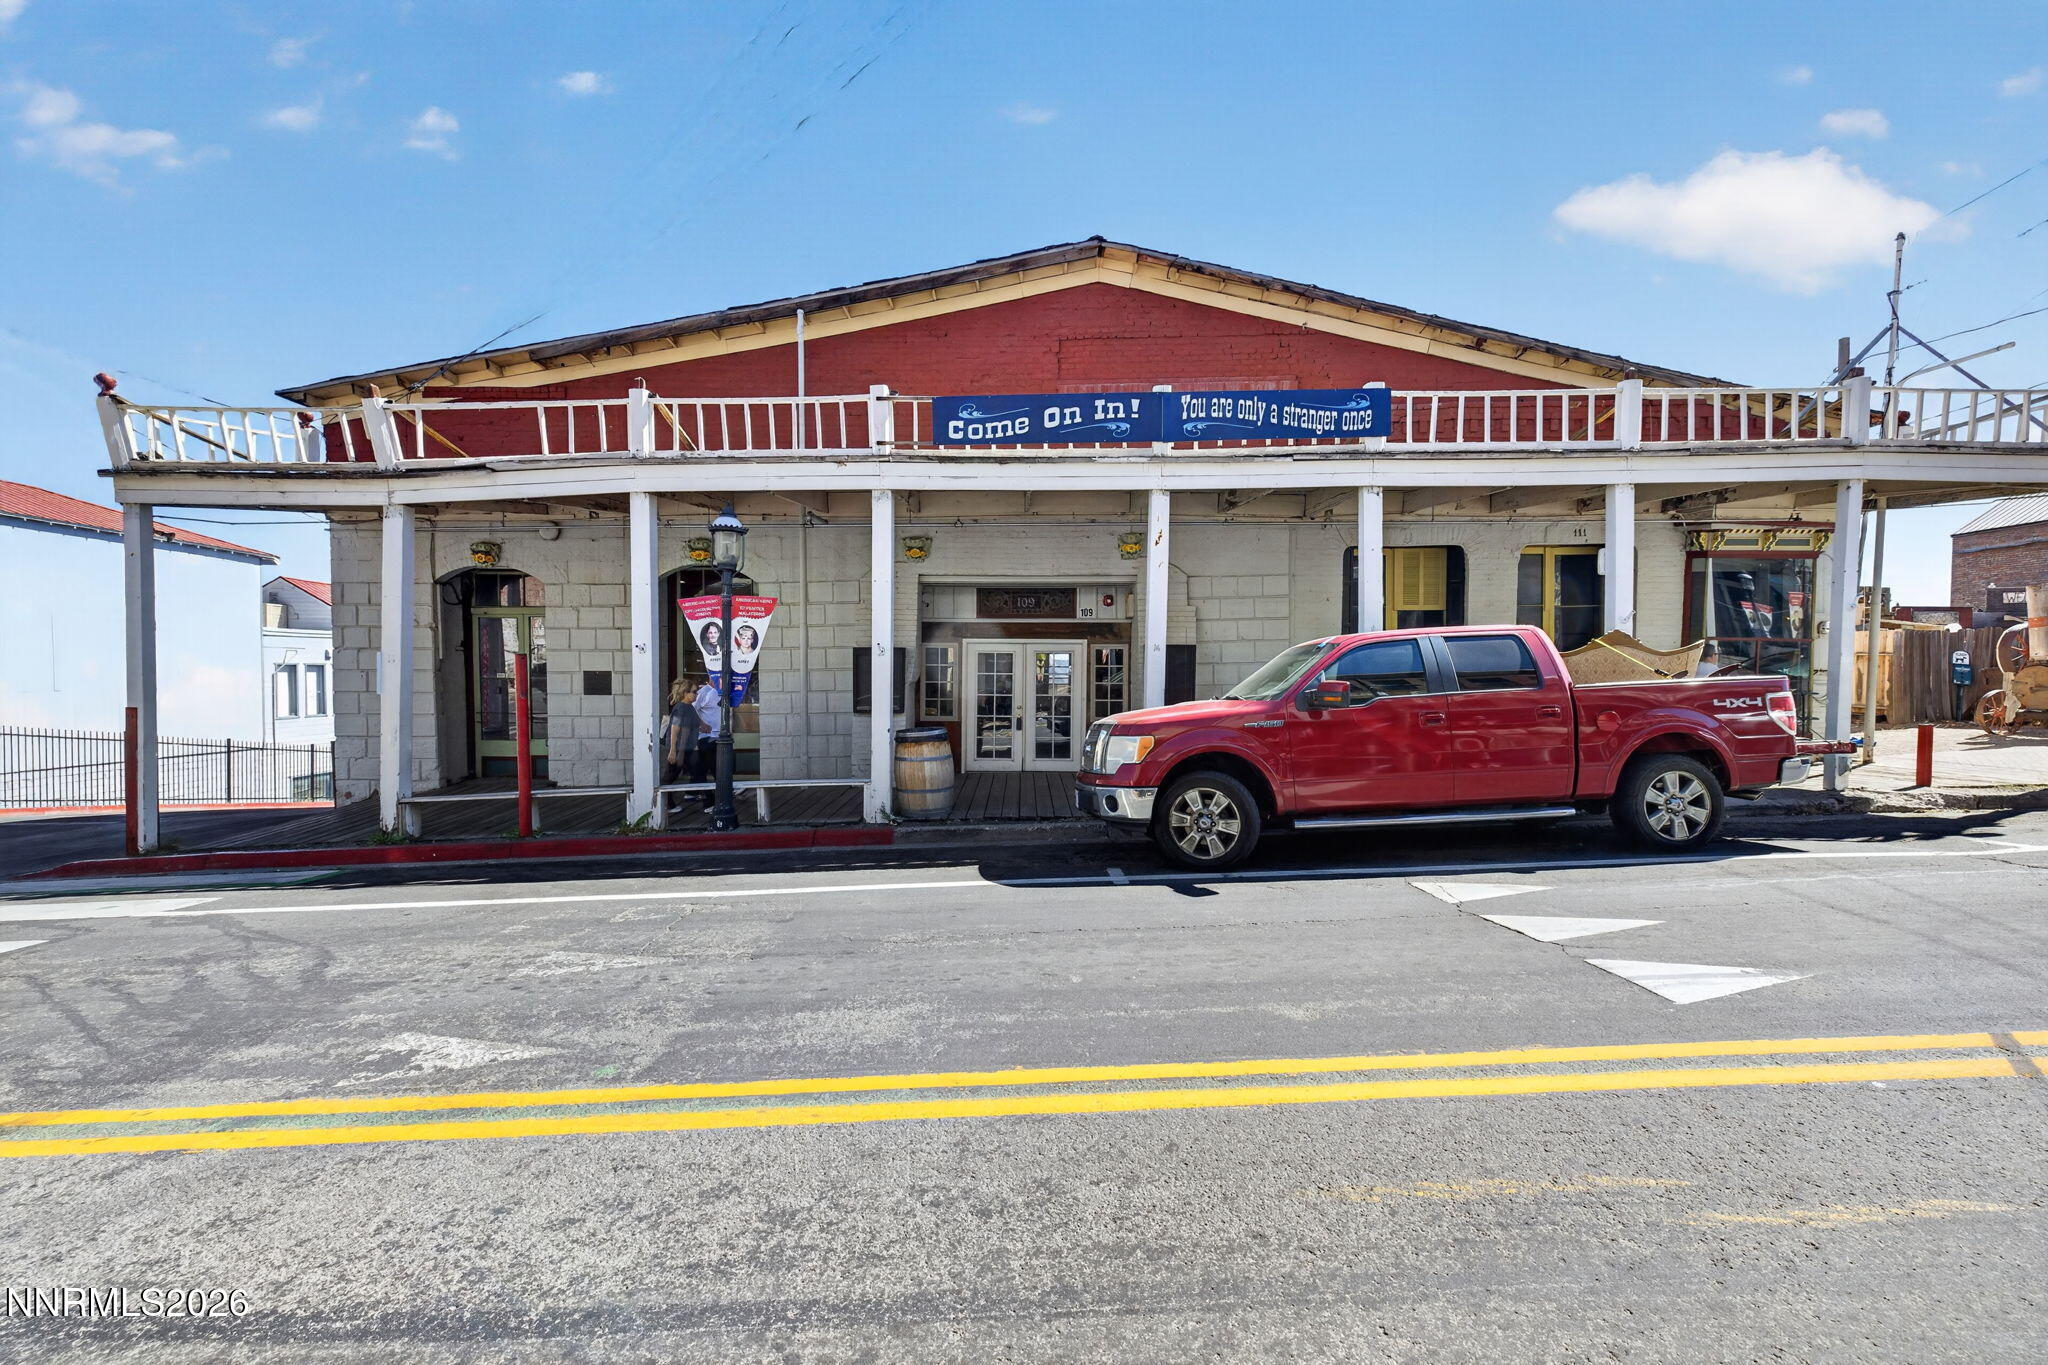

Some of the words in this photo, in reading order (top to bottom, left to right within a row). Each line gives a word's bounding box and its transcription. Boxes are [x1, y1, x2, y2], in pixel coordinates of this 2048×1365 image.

[948, 416, 1030, 440] Come
[1043, 406, 1082, 428] On
[1094, 398, 1141, 419] In!
[1181, 394, 1206, 420] You
[1211, 397, 1233, 418] are
[1237, 396, 1266, 426] only
[1270, 403, 1278, 424] a
[1282, 402, 1338, 435] stranger
[1342, 408, 1373, 431] once
[1017, 597, 1035, 608] 109
[1080, 608, 1094, 617] 109
